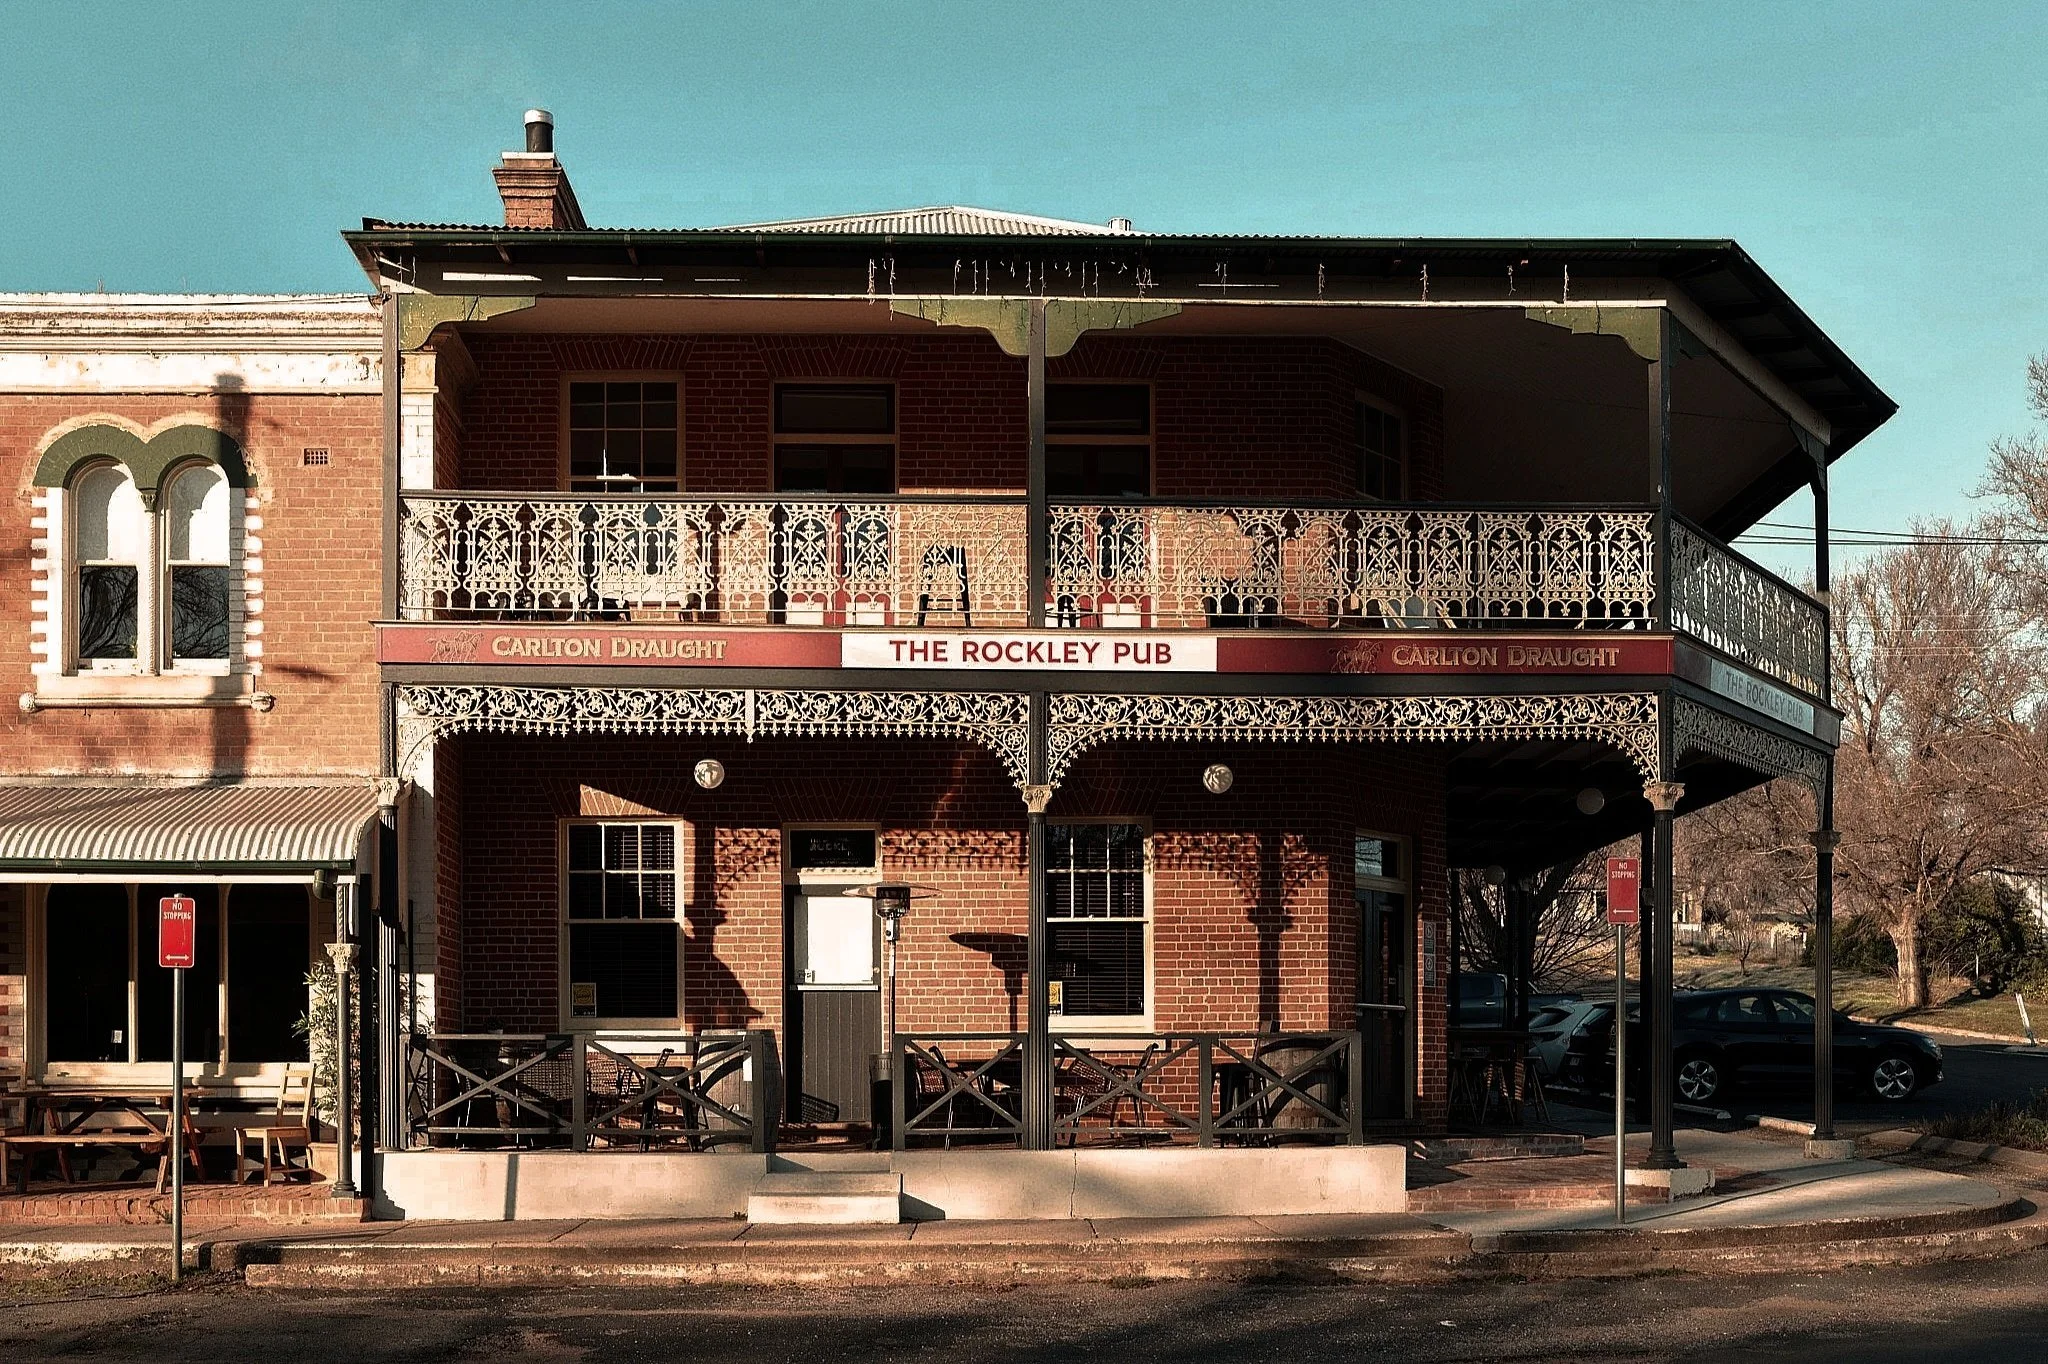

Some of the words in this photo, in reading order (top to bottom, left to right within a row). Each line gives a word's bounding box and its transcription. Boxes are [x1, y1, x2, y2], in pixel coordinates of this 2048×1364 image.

[491, 636, 602, 657] CARLTON
[611, 637, 727, 660] DRAUGHT
[889, 640, 948, 662] THE
[962, 641, 1101, 663] ROCKLEY
[1114, 642, 1172, 664] PUB
[1391, 645, 1498, 667] CARLTON
[1507, 645, 1621, 668] DRAUGHT
[1726, 671, 1743, 697] THE
[1746, 681, 1785, 716] ROCKLEY
[1618, 862, 1628, 870] NO
[1611, 870, 1636, 879] STOPPING
[172, 902, 183, 911] NO
[163, 911, 192, 920] STOPPING
